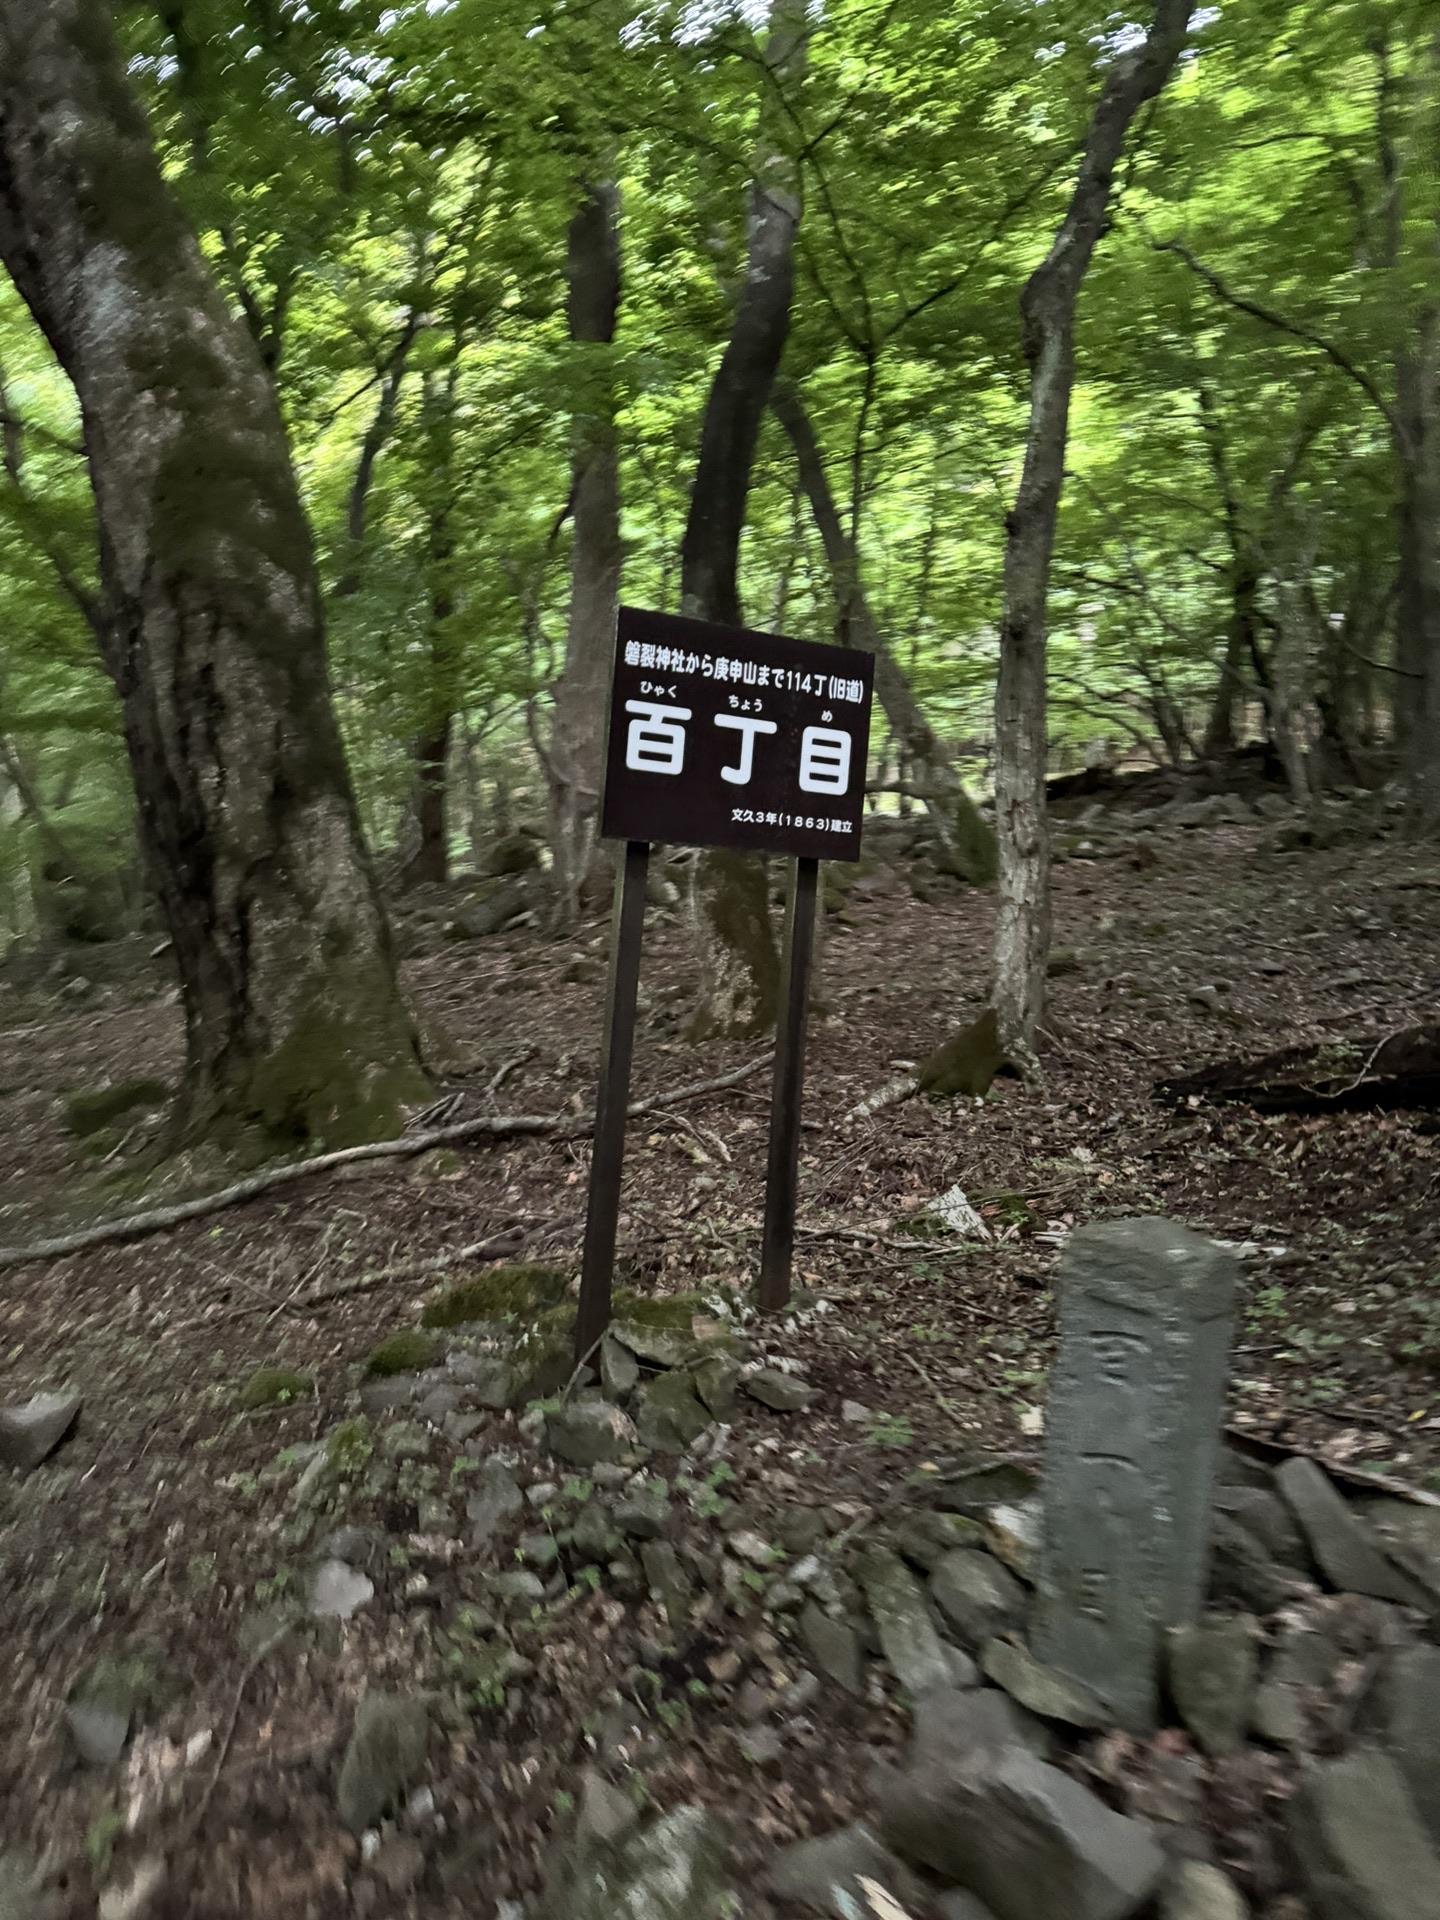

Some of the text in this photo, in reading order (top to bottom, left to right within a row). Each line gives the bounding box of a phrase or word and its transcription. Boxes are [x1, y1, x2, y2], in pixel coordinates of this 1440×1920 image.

[640, 680, 833, 723] ひゃく ちょう め
[625, 699, 852, 796] 百丁目
[731, 808, 853, 833] 文久3年(1863)建立
